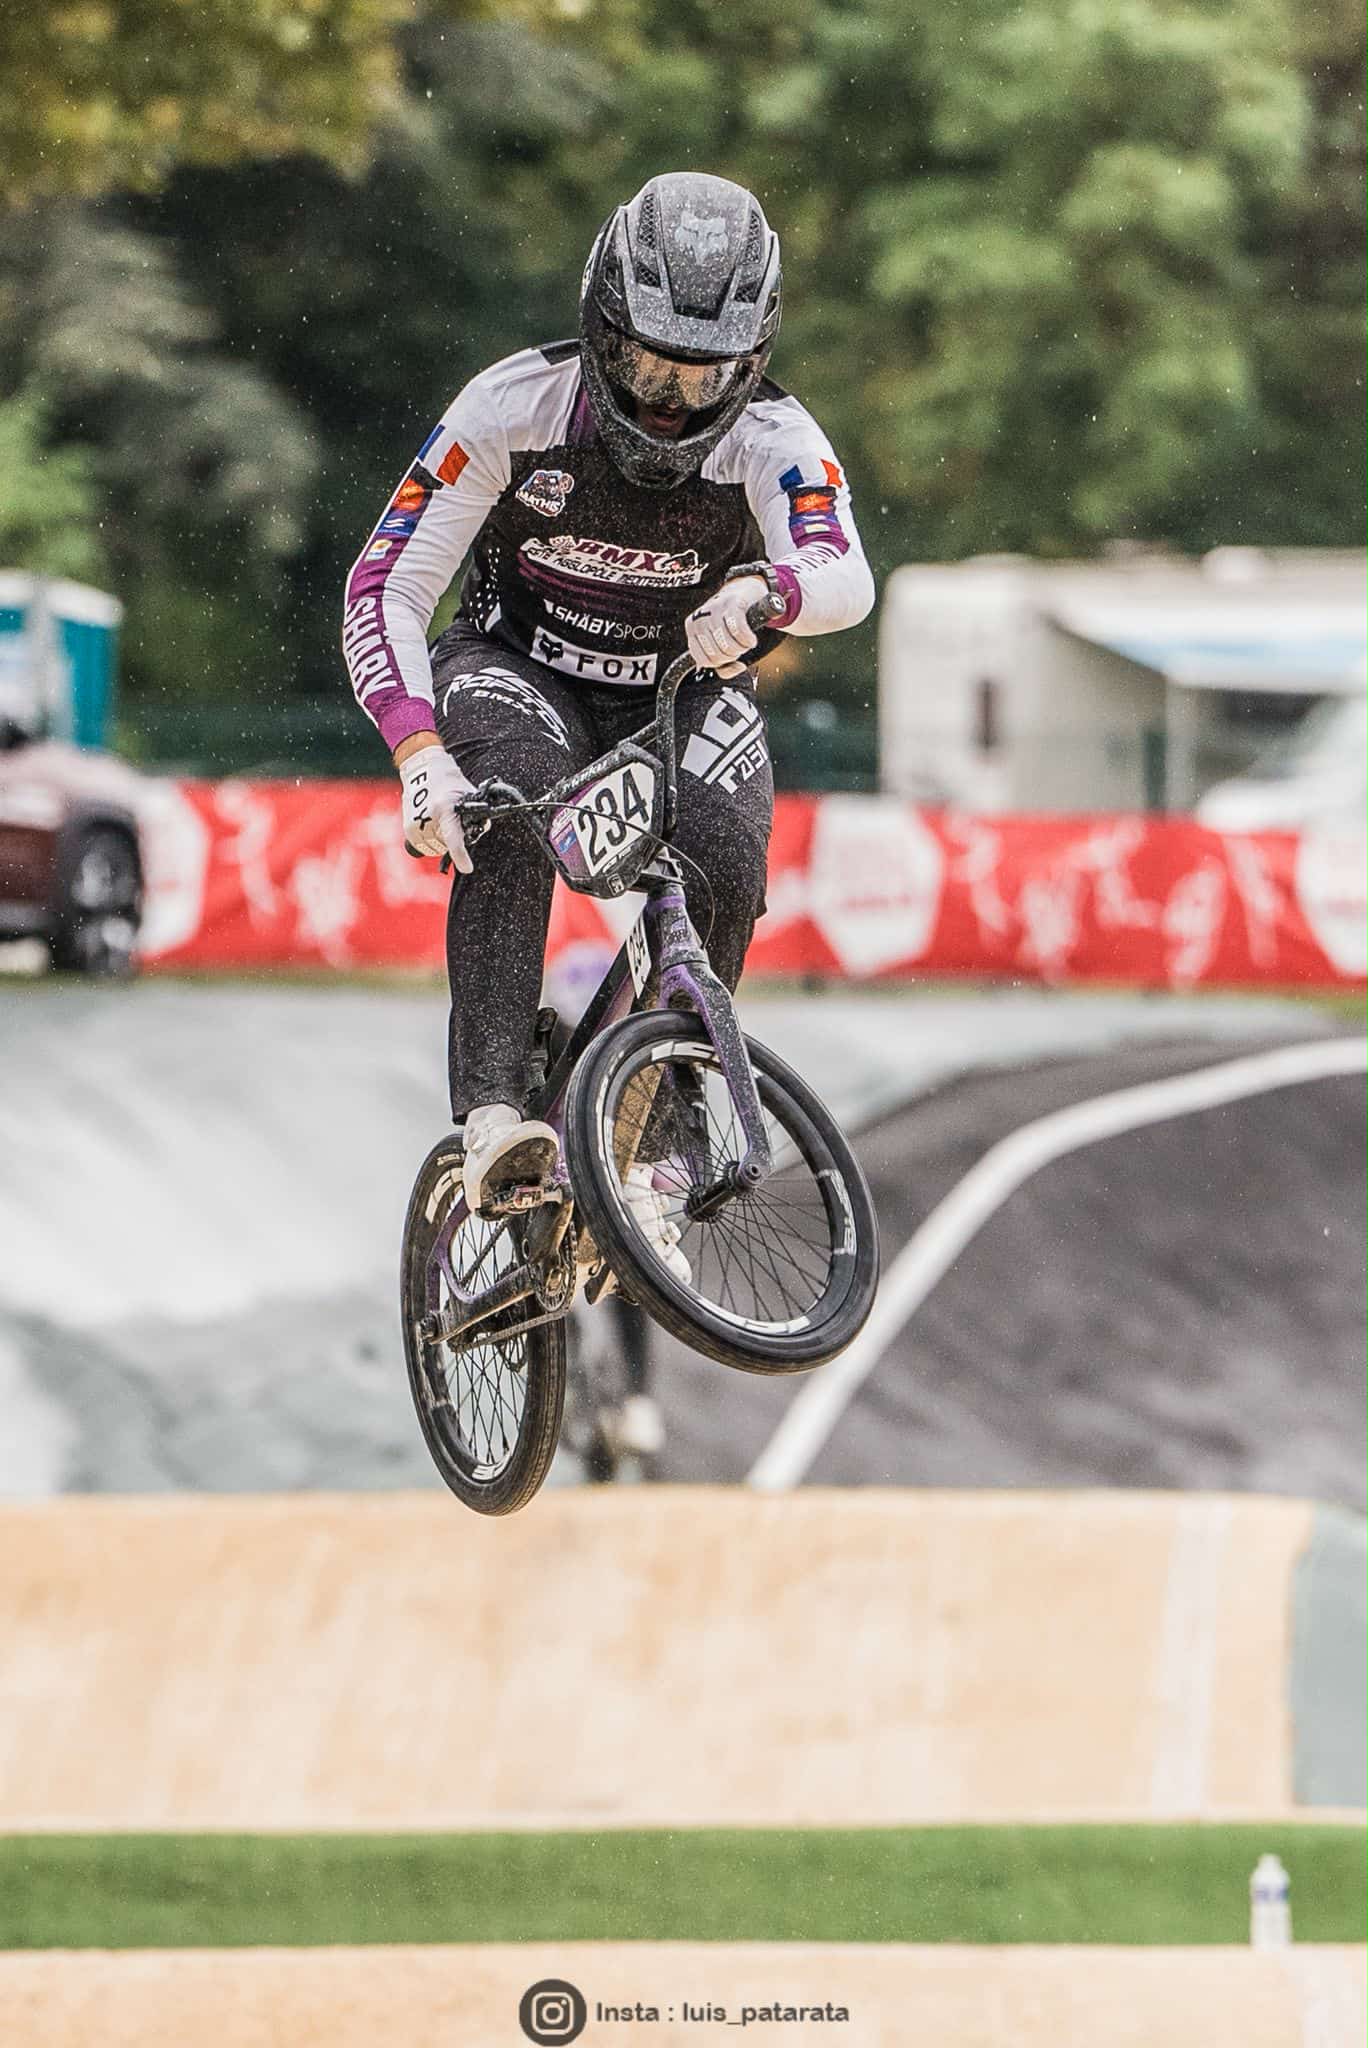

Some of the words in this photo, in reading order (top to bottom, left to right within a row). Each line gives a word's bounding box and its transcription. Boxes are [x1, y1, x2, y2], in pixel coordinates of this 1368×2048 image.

[573, 541, 667, 572] BMX
[576, 653, 651, 681] FOX
[410, 771, 432, 831] FOX
[578, 768, 650, 866] 234
